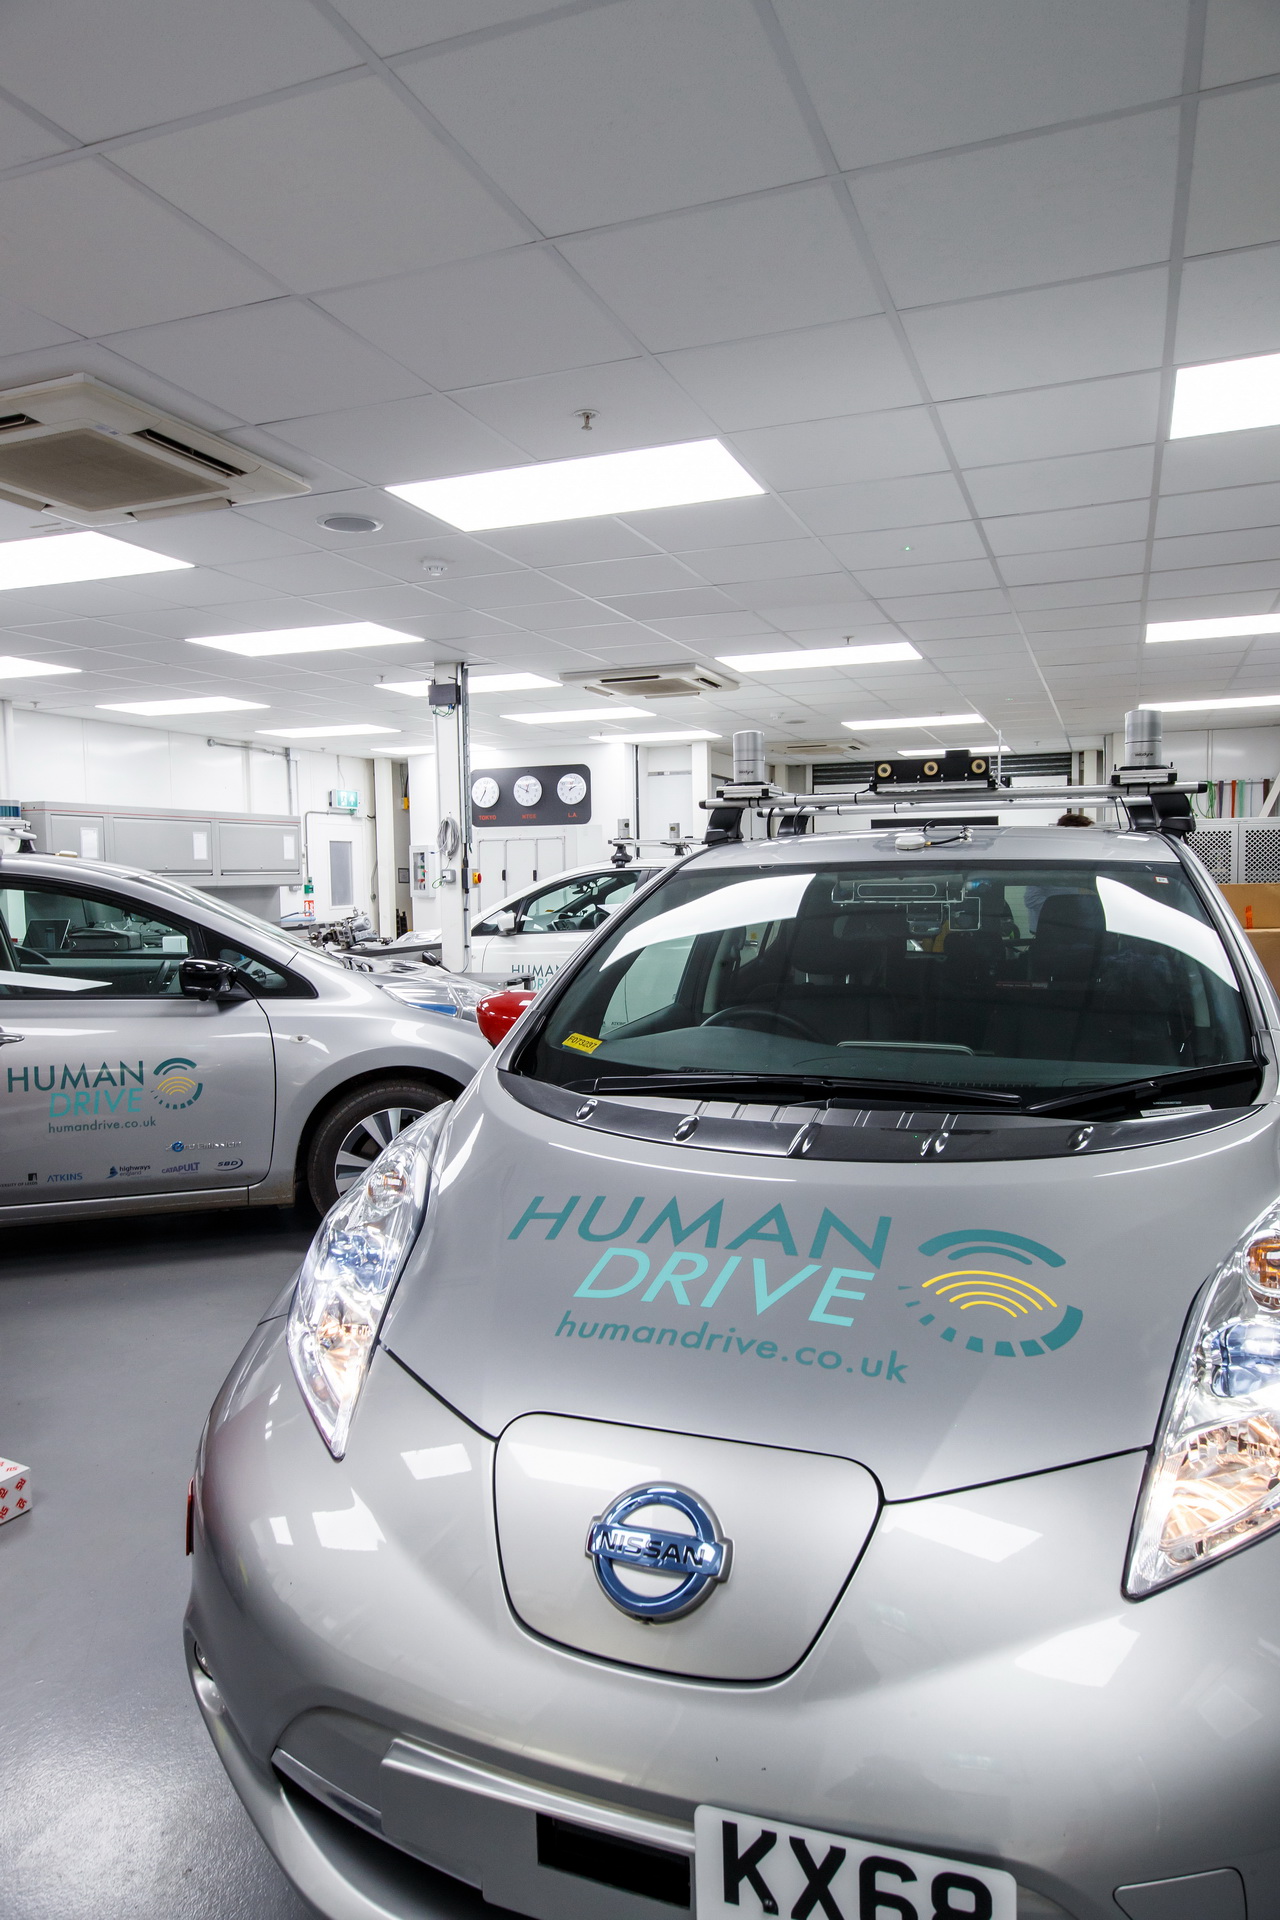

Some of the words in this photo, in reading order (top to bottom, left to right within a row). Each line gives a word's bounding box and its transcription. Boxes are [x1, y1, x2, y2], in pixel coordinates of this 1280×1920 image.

[511, 964, 560, 977] HUMA
[7, 1060, 144, 1093] HUMAN
[50, 1088, 143, 1117] DRIVE
[49, 1116, 156, 1133] humandrive.co.uk
[47, 1172, 83, 1183] ATKINS
[119, 1164, 151, 1172] highways
[161, 1162, 200, 1174] CATAPULT
[506, 1195, 892, 1269] HUMAN
[573, 1247, 875, 1327] DRIVE
[554, 1311, 909, 1383] humandrive.co.uk
[600, 1530, 705, 1568] NISSAN
[722, 1820, 994, 1920] KX68
